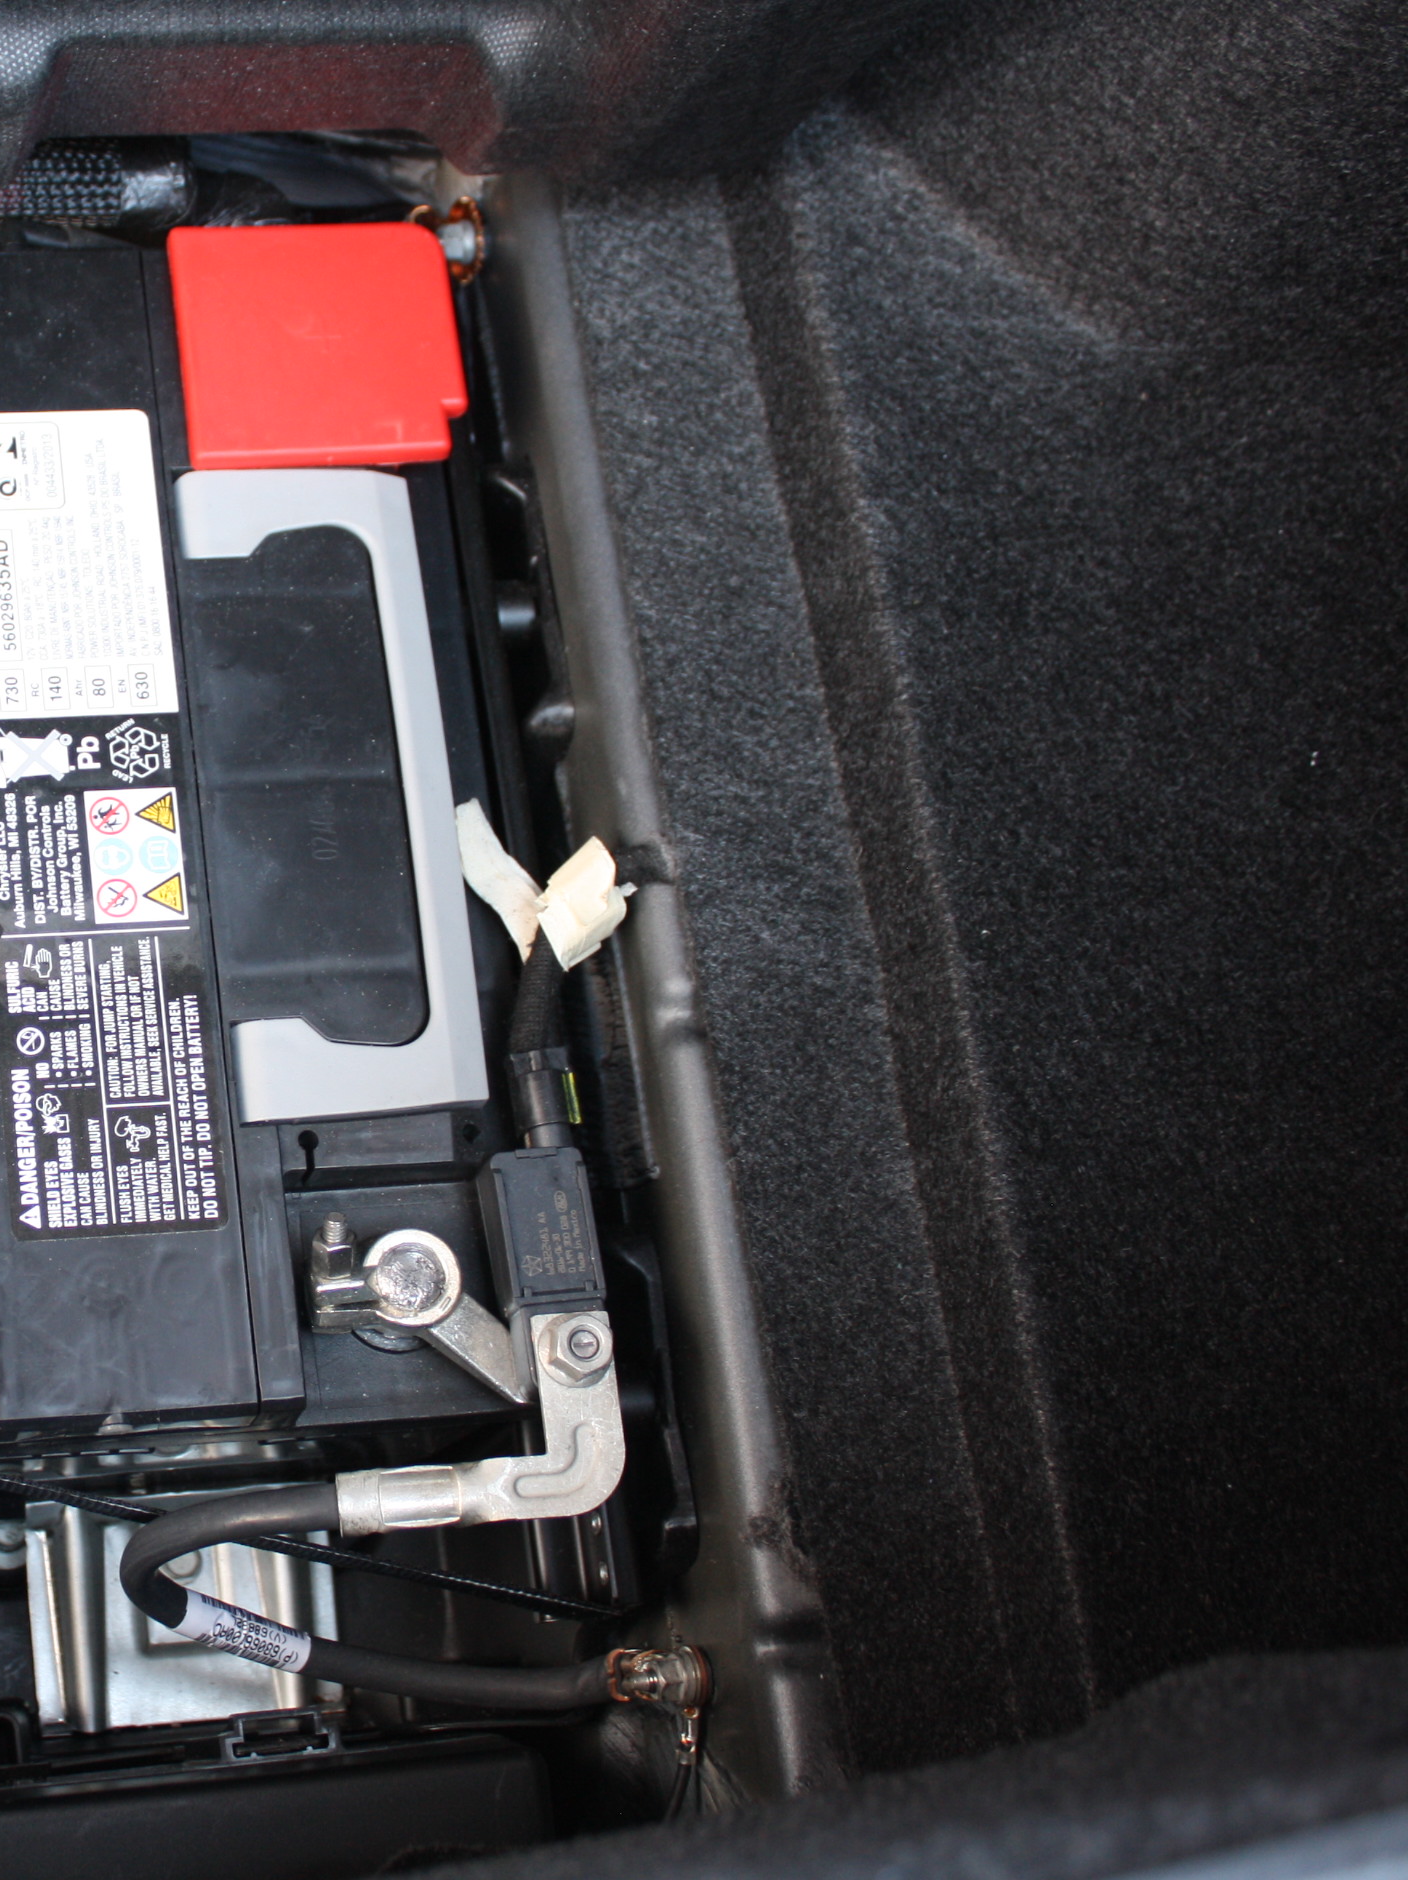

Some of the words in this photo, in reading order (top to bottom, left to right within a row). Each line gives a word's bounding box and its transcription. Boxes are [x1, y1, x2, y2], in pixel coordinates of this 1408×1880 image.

[4, 677, 18, 703] 730
[30, 684, 39, 696] RC
[48, 676, 61, 700] 140
[91, 678, 105, 696] 80
[118, 679, 126, 693] EN
[134, 671, 149, 699] 630
[103, 717, 137, 740] RETURN
[76, 736, 101, 769] Pb
[128, 744, 140, 759] Pb
[160, 733, 170, 768] RECYCLE
[111, 768, 134, 784] LEAD
[4, 793, 17, 829] 48326
[24, 795, 37, 822] POR
[52, 801, 64, 823] Inc.
[64, 794, 77, 830] 53209
[7, 831, 19, 847] MI
[39, 805, 53, 857] Controls
[56, 824, 69, 867] Group,
[65, 833, 79, 849] WI
[9, 850, 21, 880] Hills,
[27, 825, 43, 888] BY/DISTR.
[45, 860, 58, 913] Johnson
[59, 870, 73, 916] Battery
[69, 852, 85, 921] Milwaukee,
[13, 883, 26, 928] Auburn
[32, 892, 46, 924] DIST.
[58, 944, 71, 957] OR
[71, 941, 85, 972] BURNS
[110, 945, 125, 981] VEHICLE
[137, 936, 153, 988] ASSISTANCE.
[4, 961, 23, 1013] SULFURIC
[48, 979, 62, 1011] CAUSE
[59, 958, 75, 1010] BLINDNESS
[74, 974, 88, 1009] SEVERE
[98, 960, 113, 1006] STARTING,
[114, 983, 126, 992] IN
[127, 975, 140, 993] NOT
[20, 986, 36, 1012] ACID
[35, 991, 49, 1011] CAN
[129, 995, 141, 1003] IF
[130, 1004, 142, 1017] OR
[142, 990, 157, 1024] SERVICE
[102, 1008, 116, 1032] JUMP
[115, 994, 132, 1058] INSTRUCTIONS
[168, 997, 185, 1058] CHILDREN.
[183, 995, 202, 1054] BATTERY!
[49, 1031, 64, 1069] SPARKS
[64, 1030, 78, 1068] FLAMES
[78, 1023, 94, 1067] SMOKING
[104, 1034, 117, 1052] FOR
[132, 1019, 146, 1056] MANUAL
[146, 1026, 159, 1046] SEEK
[35, 1062, 49, 1078] NO
[106, 1056, 121, 1098] CAUTION:
[121, 1060, 135, 1097] FOLLOW
[135, 1058, 150, 1096] OWNERS
[148, 1048, 164, 1095] AVAILABLE,
[174, 1061, 186, 1075] OF
[189, 1057, 206, 1090] OPEN
[175, 1078, 190, 1117] REACH
[192, 1094, 208, 1119] NOT
[11, 1069, 39, 1204] DANGER/POISON
[87, 1118, 101, 1153] INJURY
[154, 1112, 167, 1136] FAST.
[179, 1120, 192, 1142] THE
[195, 1123, 211, 1140] DO
[57, 1137, 73, 1169] GASES
[90, 1155, 103, 1168] OR
[156, 1138, 170, 1160] HELP
[182, 1145, 194, 1160] OF
[198, 1145, 213, 1168] TIP.
[43, 1161, 59, 1188] EYES
[76, 1172, 91, 1203] CAUSE
[116, 1165, 129, 1189] EYES
[129, 1157, 146, 1222] IMMEDIATELY
[144, 1157, 158, 1194] WATER.
[159, 1162, 173, 1201] MEDICAL
[183, 1163, 197, 1186] OUT
[200, 1171, 216, 1196] NOT
[46, 1190, 62, 1227] SHIELD
[60, 1172, 77, 1226] EXPLOSIVE
[91, 1171, 108, 1224] BLINDNESS
[118, 1191, 132, 1223] FLUSH
[148, 1196, 161, 1221] WITH
[162, 1203, 175, 1220] GET
[186, 1190, 200, 1219] KEEP
[203, 1200, 218, 1218] DO
[79, 1205, 93, 1225] CAN
[537, 1211, 547, 1224] AA
[570, 1209, 581, 1238] Mexico
